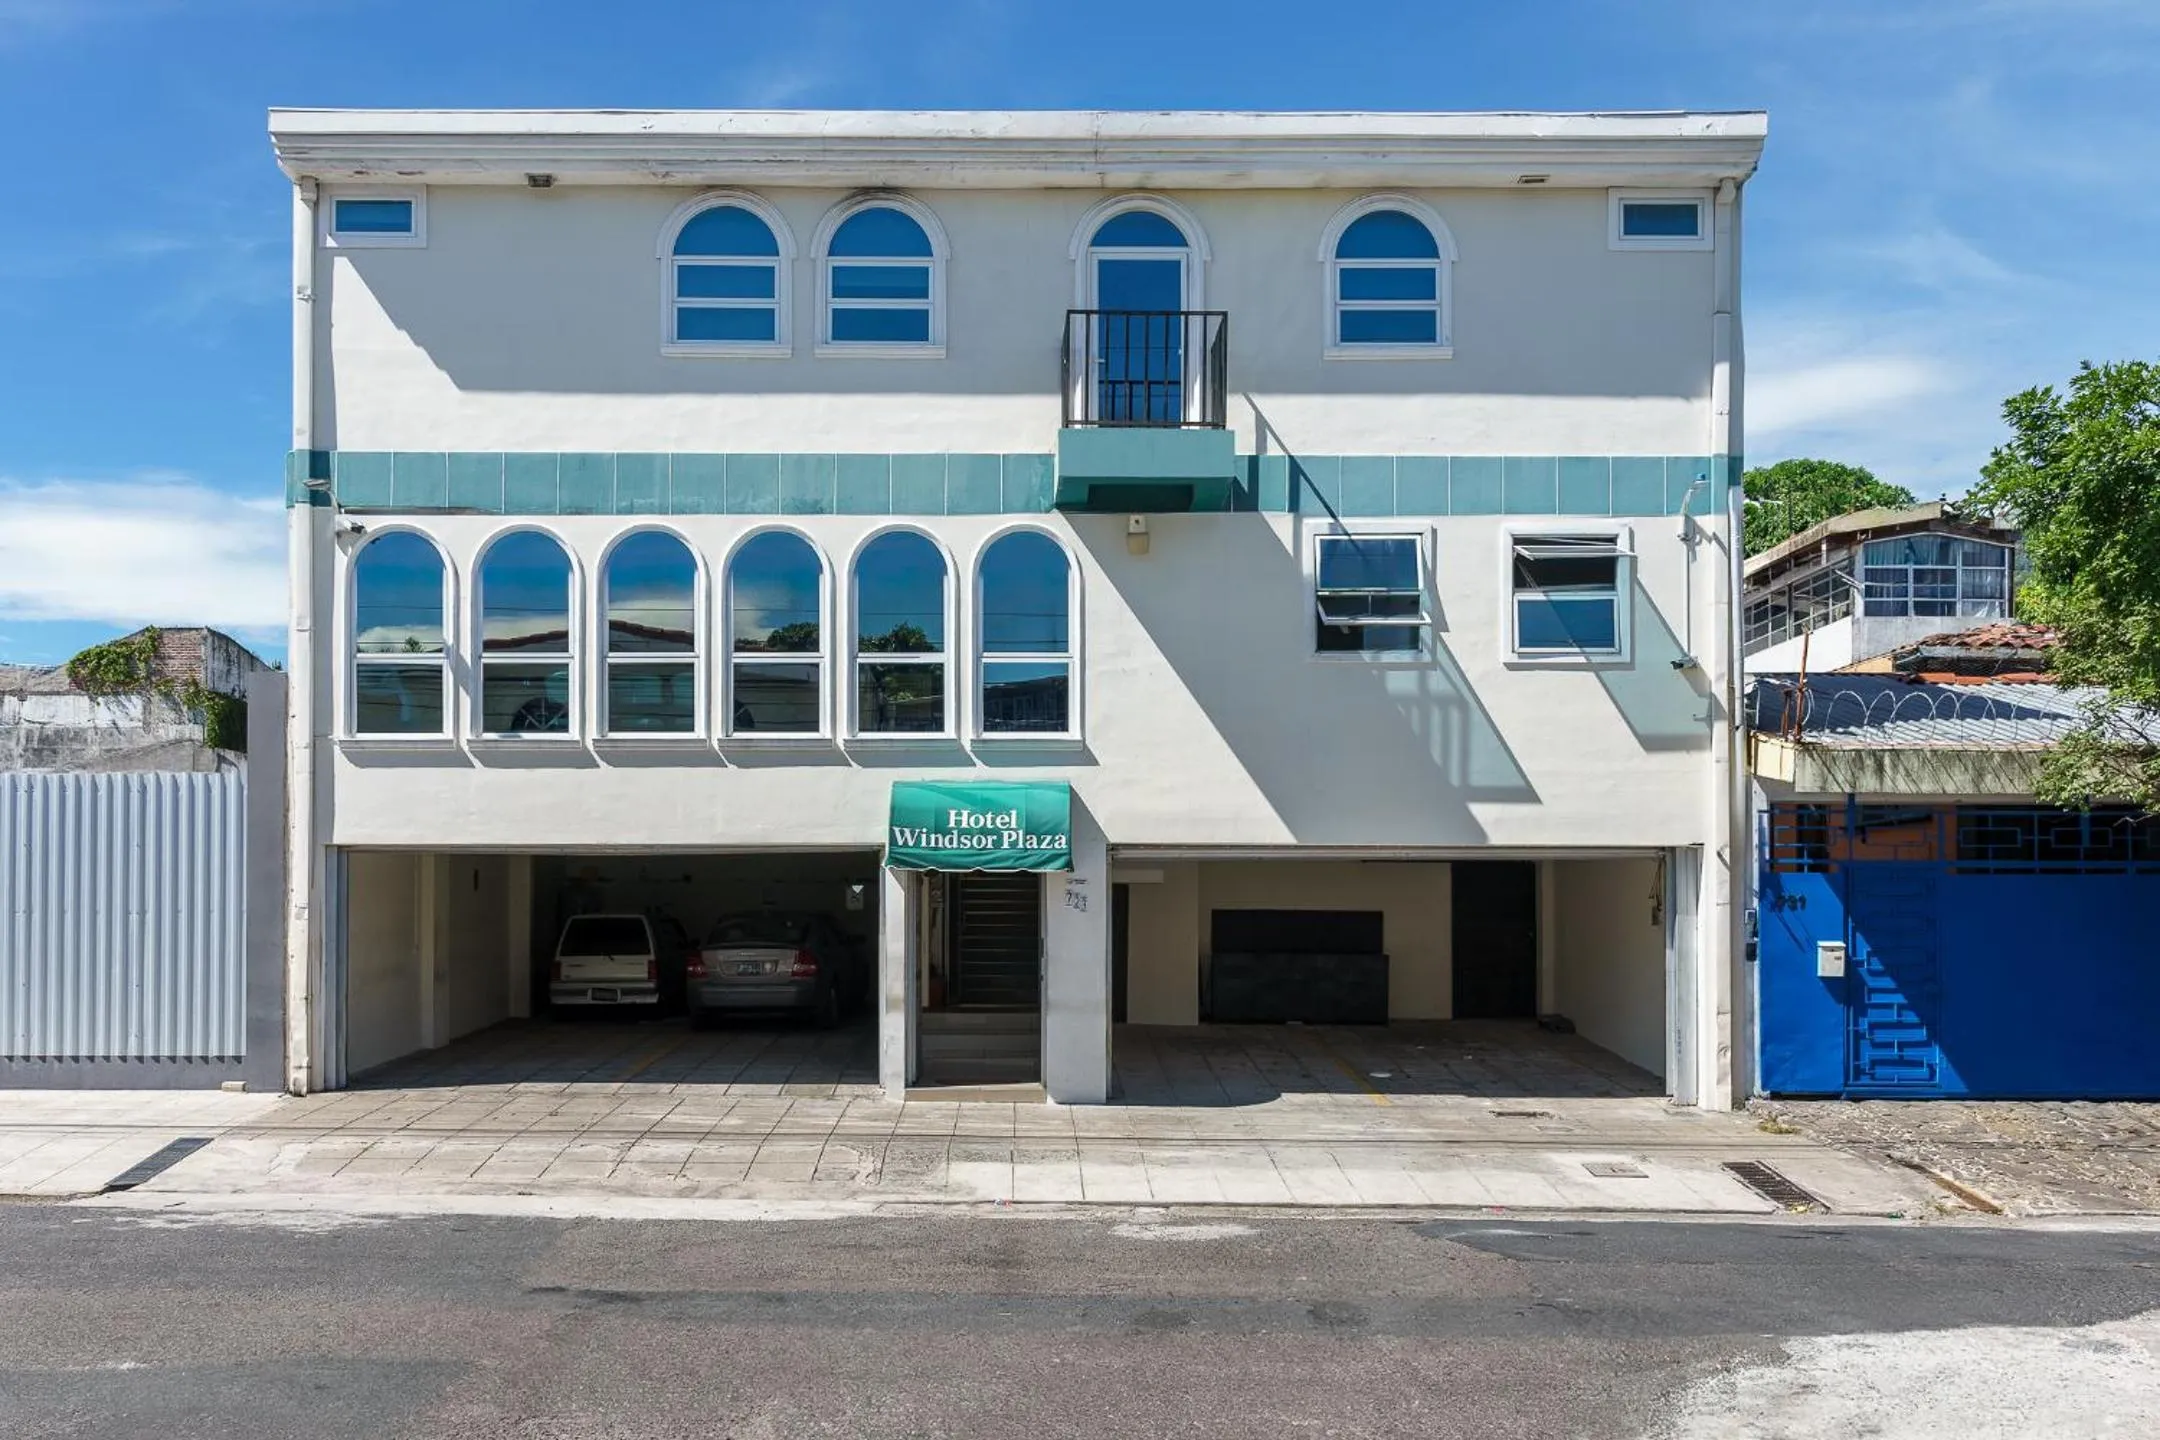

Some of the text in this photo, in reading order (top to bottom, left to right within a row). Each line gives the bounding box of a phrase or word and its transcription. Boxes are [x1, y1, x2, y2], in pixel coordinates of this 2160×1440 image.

[948, 809, 1017, 829] Hotel
[892, 827, 1067, 849] Windsor Plaza
